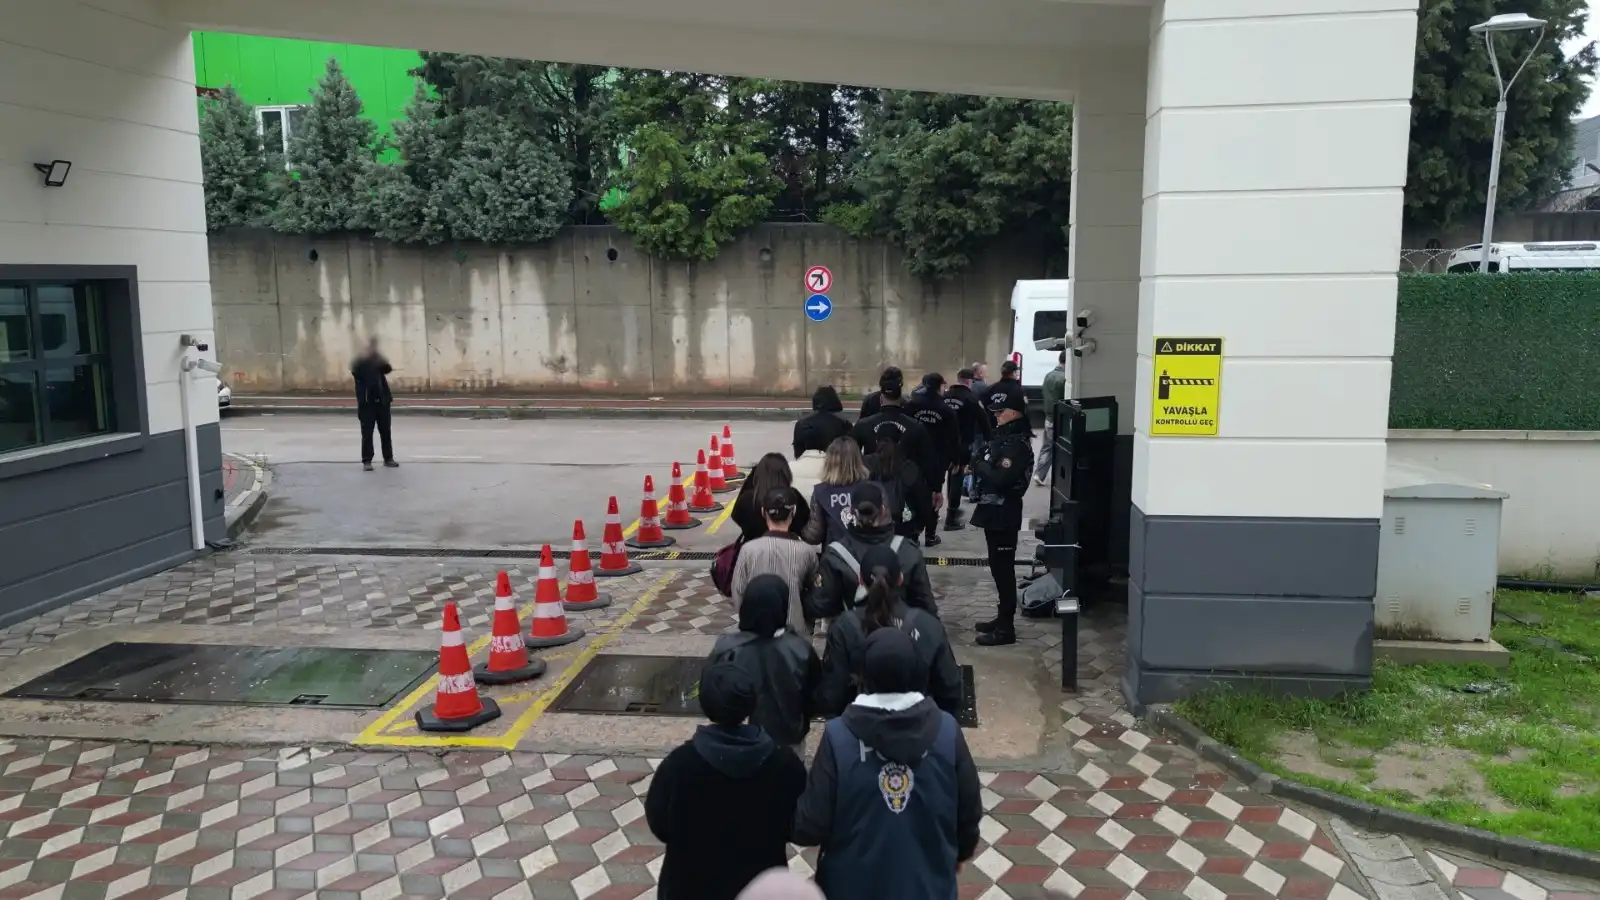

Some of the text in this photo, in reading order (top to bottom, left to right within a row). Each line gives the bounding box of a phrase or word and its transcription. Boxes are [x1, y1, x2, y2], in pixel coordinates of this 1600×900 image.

[1176, 342, 1216, 352] DİKKAT
[1163, 406, 1208, 417] YAVAŞLA
[1155, 418, 1214, 427] KONTROLLÜ GEÇ
